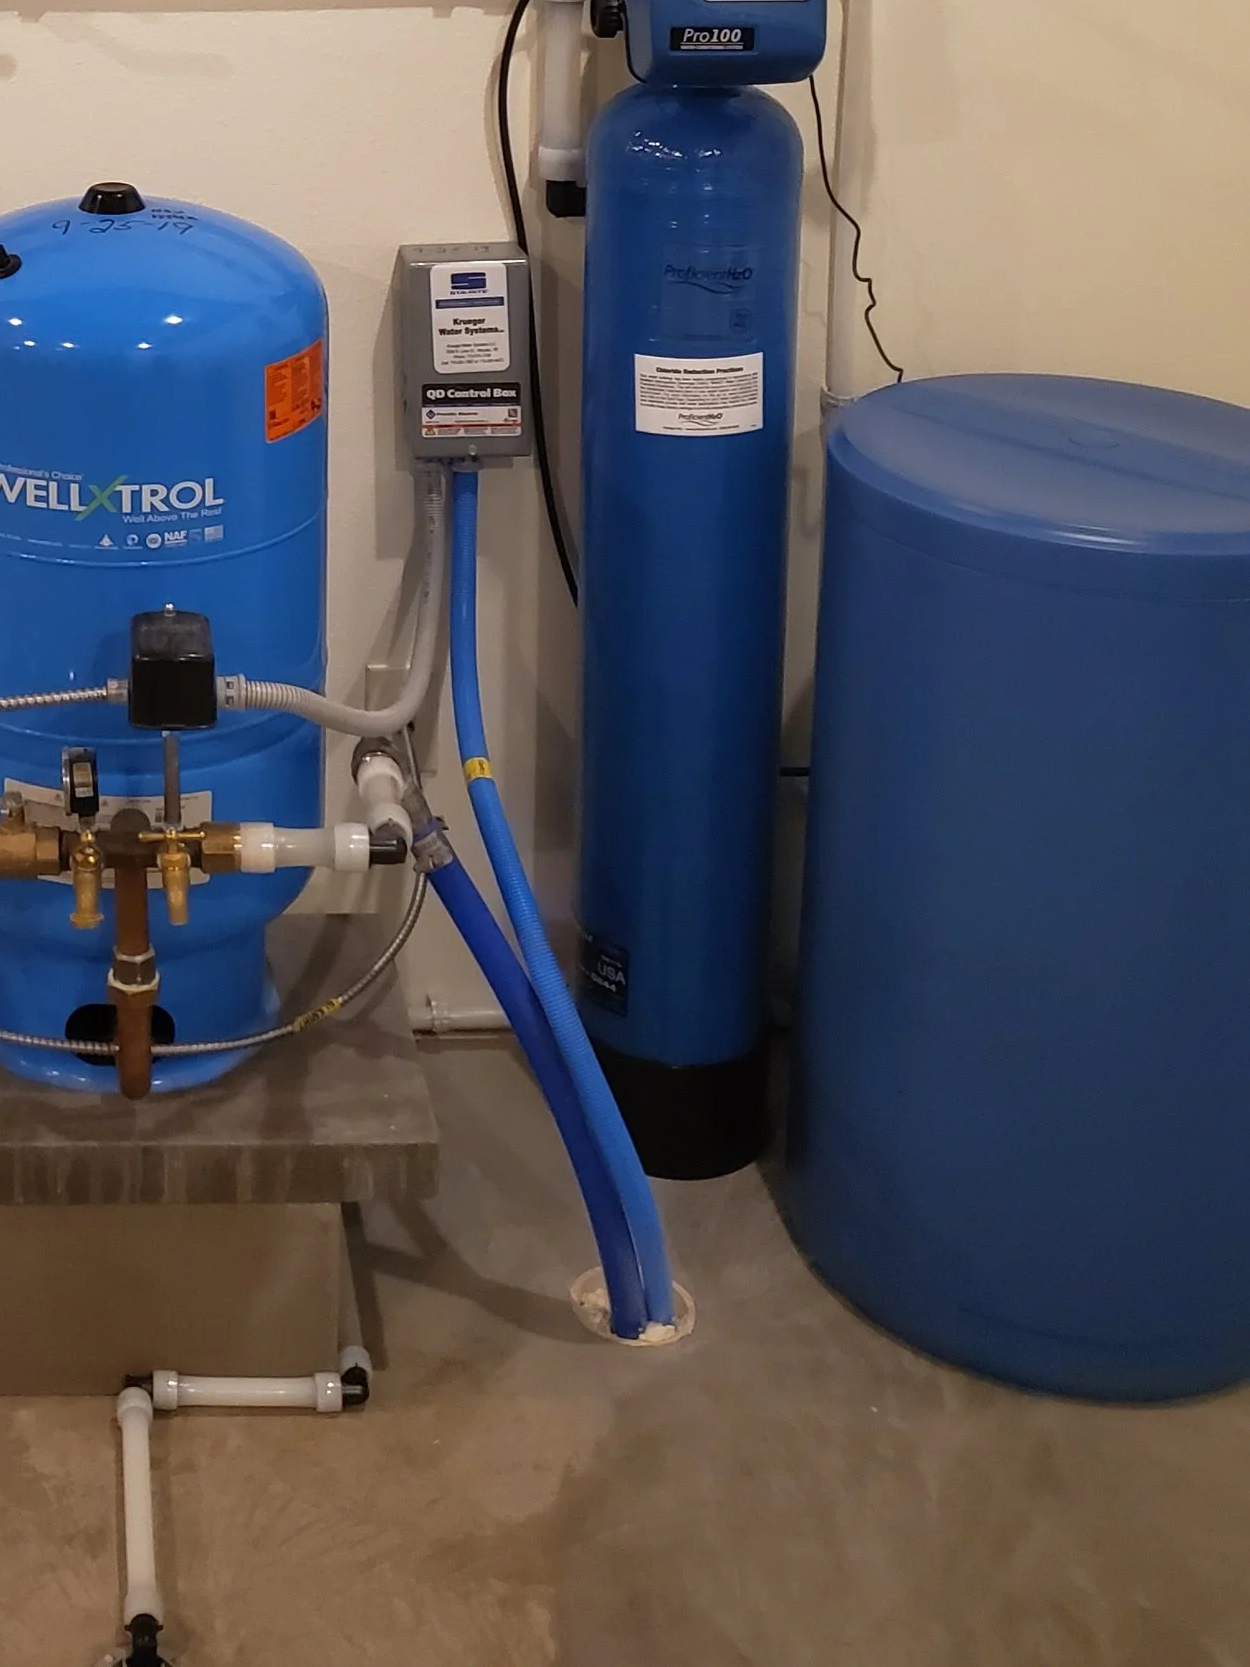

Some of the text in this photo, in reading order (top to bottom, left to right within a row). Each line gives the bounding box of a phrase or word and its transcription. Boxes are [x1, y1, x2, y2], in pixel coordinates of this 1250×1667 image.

[682, 28, 743, 43] Pro100
[452, 317, 486, 327] Krueger
[438, 327, 463, 336] Water
[464, 326, 499, 336] Systems
[426, 387, 517, 400] QD Control Box
[51, 469, 83, 481] Choice
[122, 507, 222, 524] Well Above The Rest
[597, 960, 626, 986] USA
